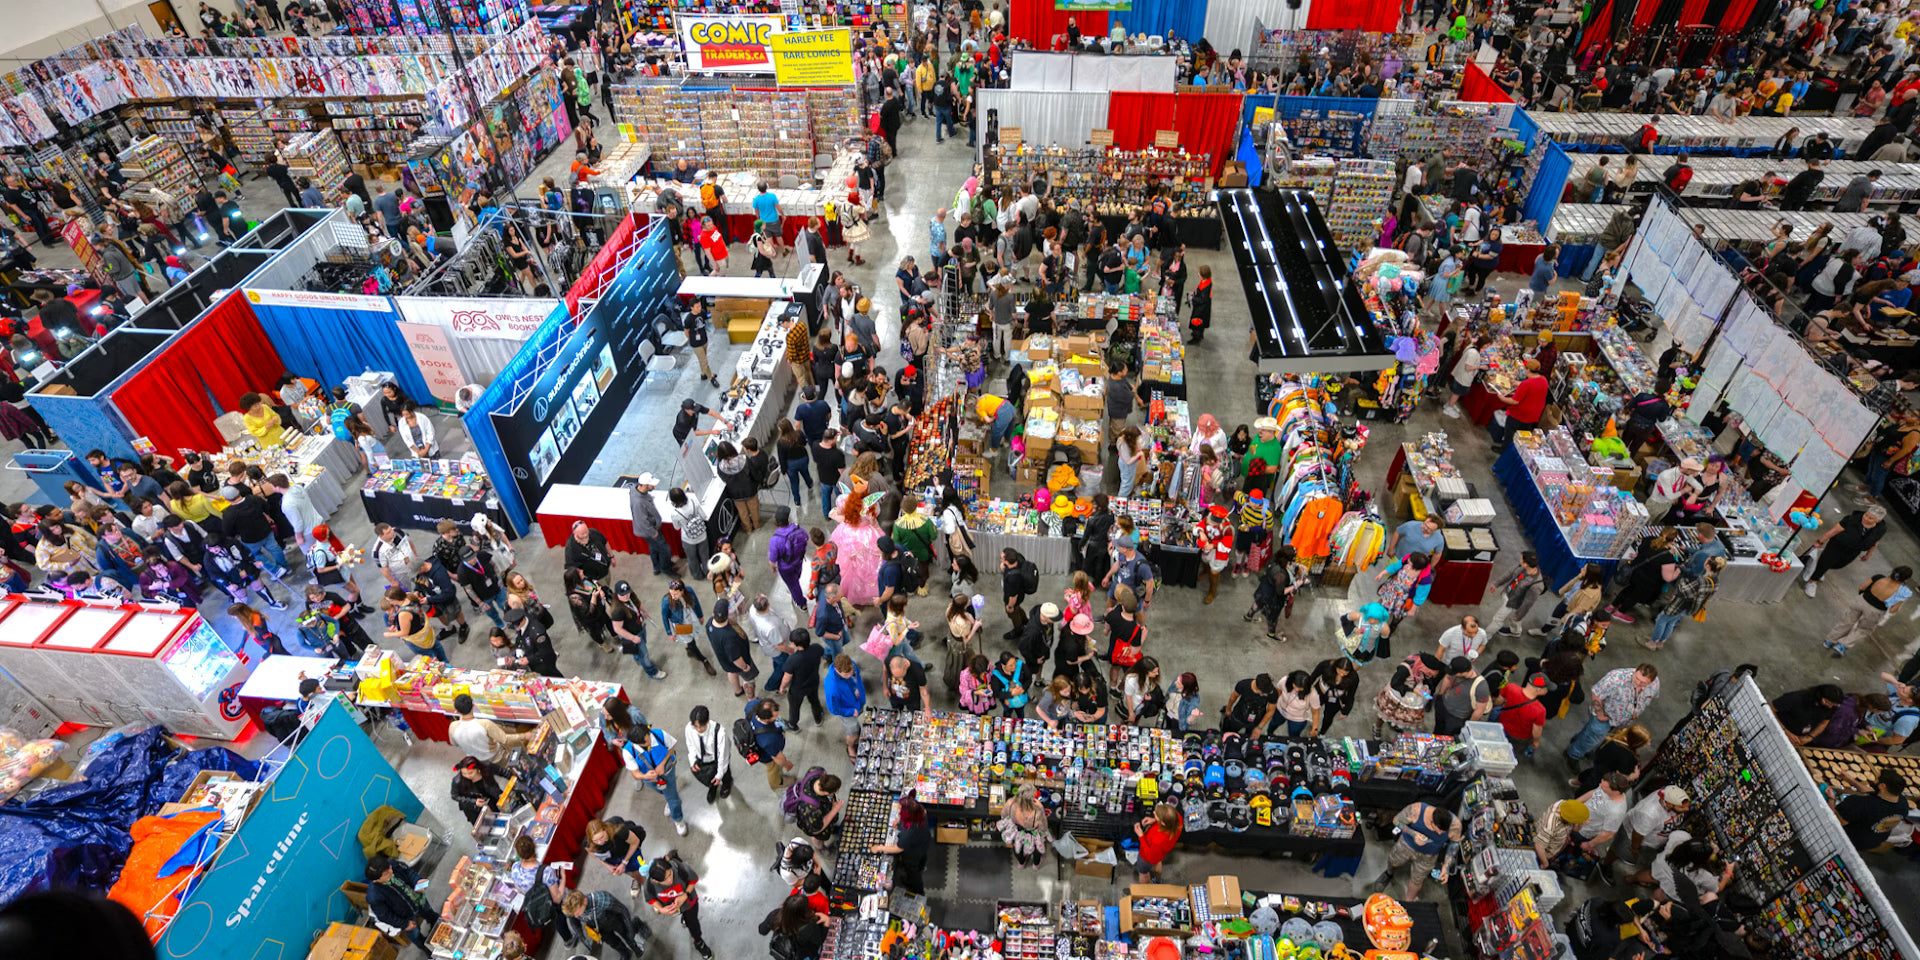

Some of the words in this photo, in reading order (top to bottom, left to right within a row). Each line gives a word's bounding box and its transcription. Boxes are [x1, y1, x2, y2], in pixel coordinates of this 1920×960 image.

[690, 20, 772, 46] COMIC
[784, 35, 817, 44] HARLEY
[819, 34, 834, 42] YEE
[703, 49, 766, 61] TRADERS.CA
[783, 51, 805, 59] RARE
[807, 49, 841, 58] COMICS
[320, 294, 358, 302] UNLIMITED
[495, 314, 521, 322] OWL'S
[508, 323, 538, 331] BOOKS
[420, 359, 453, 368] BOOKS
[547, 336, 594, 402] audio-technica
[225, 811, 310, 930] Sparetime
